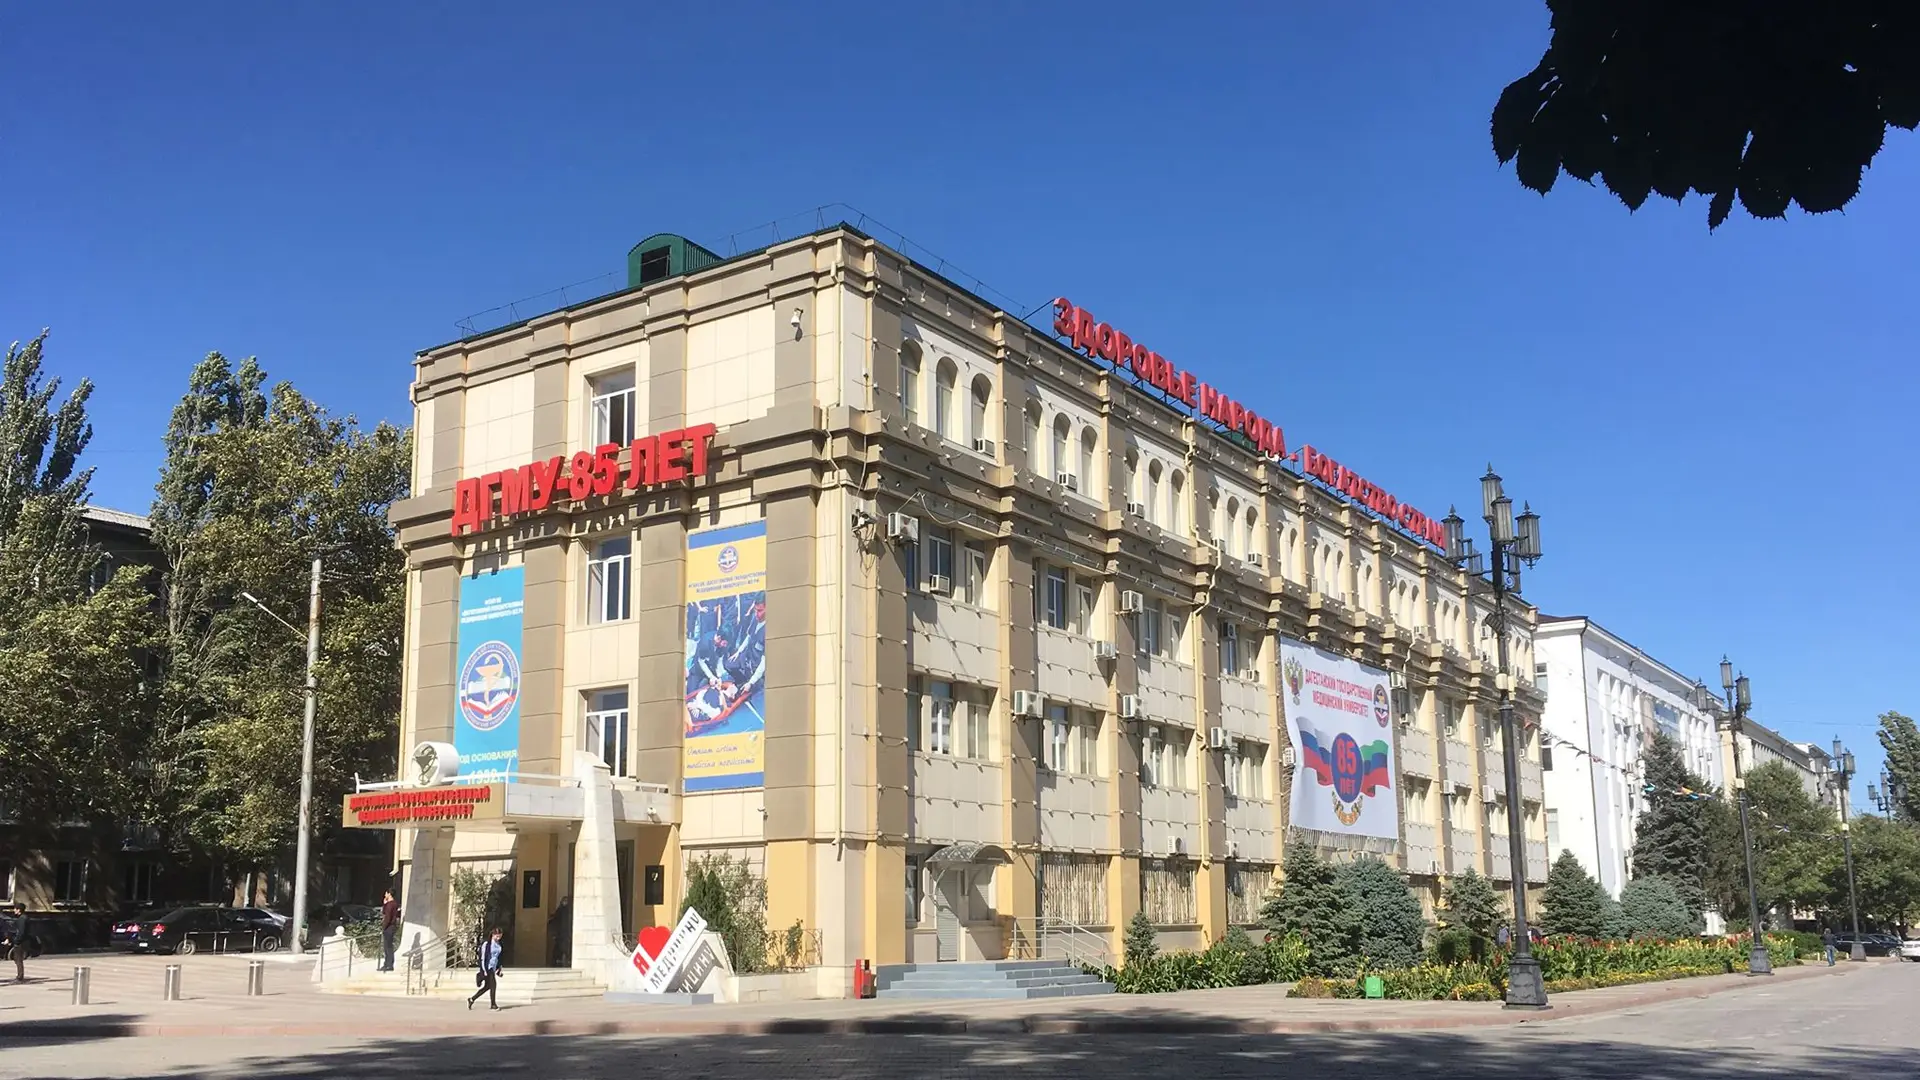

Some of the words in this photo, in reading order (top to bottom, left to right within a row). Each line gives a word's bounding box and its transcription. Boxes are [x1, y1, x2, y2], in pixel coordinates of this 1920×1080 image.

[1053, 297, 1197, 409] ЗДОРОВЬЕ
[1199, 383, 1287, 459] НАРОДА
[1303, 444, 1399, 520] БОГАТСТВО
[451, 443, 619, 537] ДГМУ-85
[626, 422, 716, 490] ЛЕТ
[471, 749, 517, 762] ОСНОВАНИЯ
[1336, 737, 1357, 775] 85
[633, 952, 650, 977] Я
